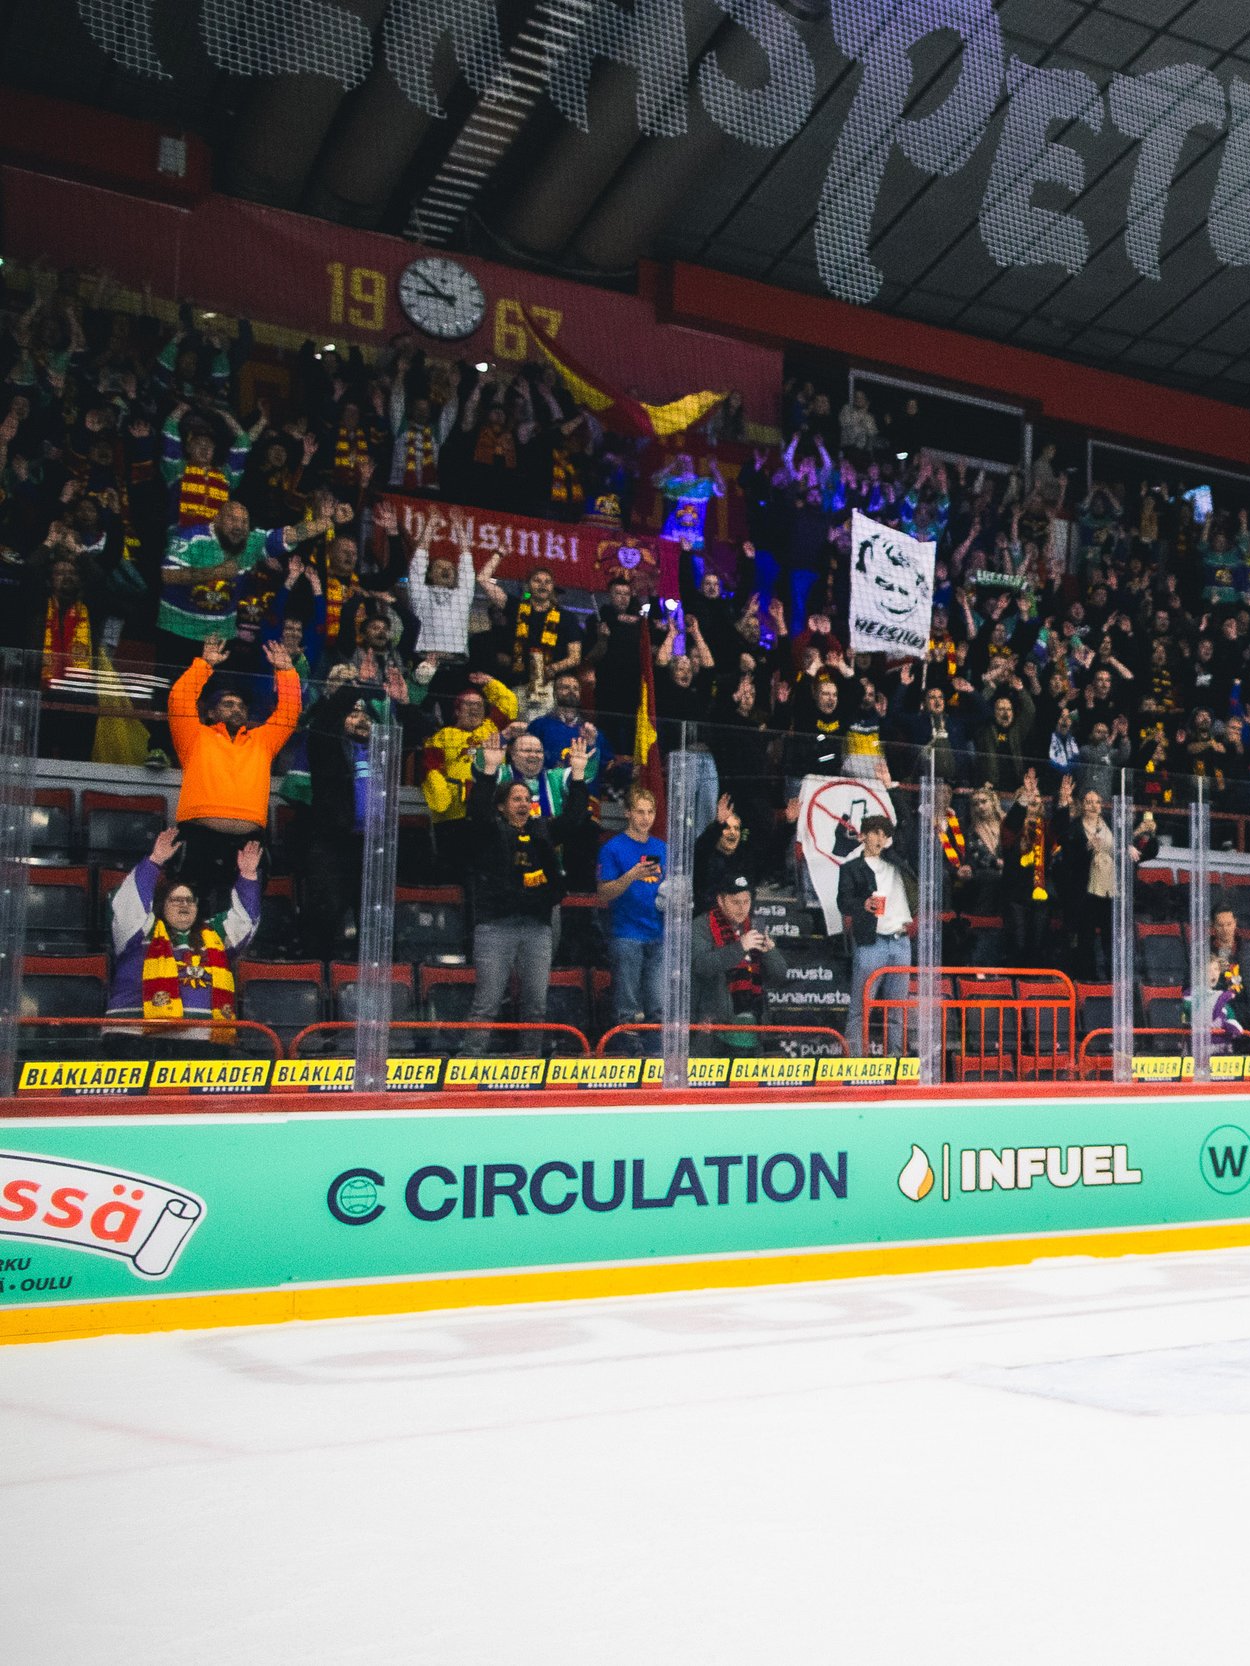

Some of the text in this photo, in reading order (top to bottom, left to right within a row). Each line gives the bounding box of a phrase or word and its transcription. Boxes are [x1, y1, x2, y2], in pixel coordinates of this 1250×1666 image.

[327, 262, 387, 331] 19
[404, 1150, 849, 1222] CIRCULATION
[960, 1143, 1143, 1193] INFUEL
[20, 1276, 73, 1292] OULU
